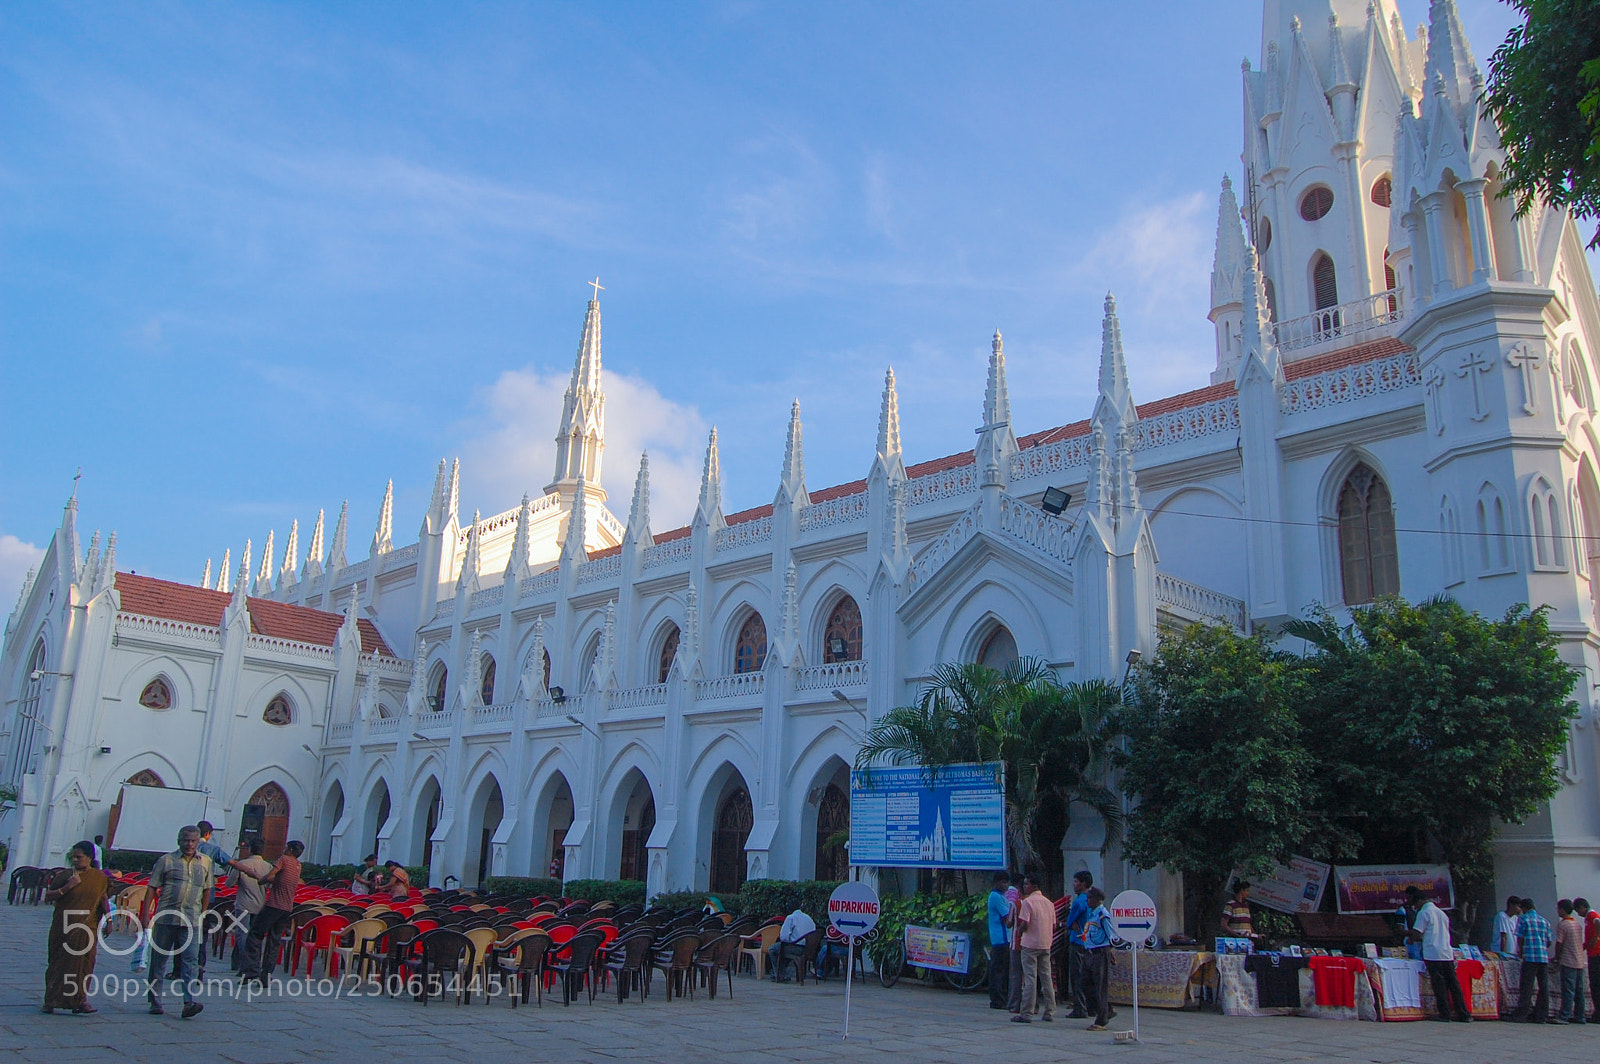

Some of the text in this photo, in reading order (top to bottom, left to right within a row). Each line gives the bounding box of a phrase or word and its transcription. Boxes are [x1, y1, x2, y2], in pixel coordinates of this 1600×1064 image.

[829, 900, 878, 915] NO PARKING
[1112, 908, 1155, 917] TWO WHEELERS
